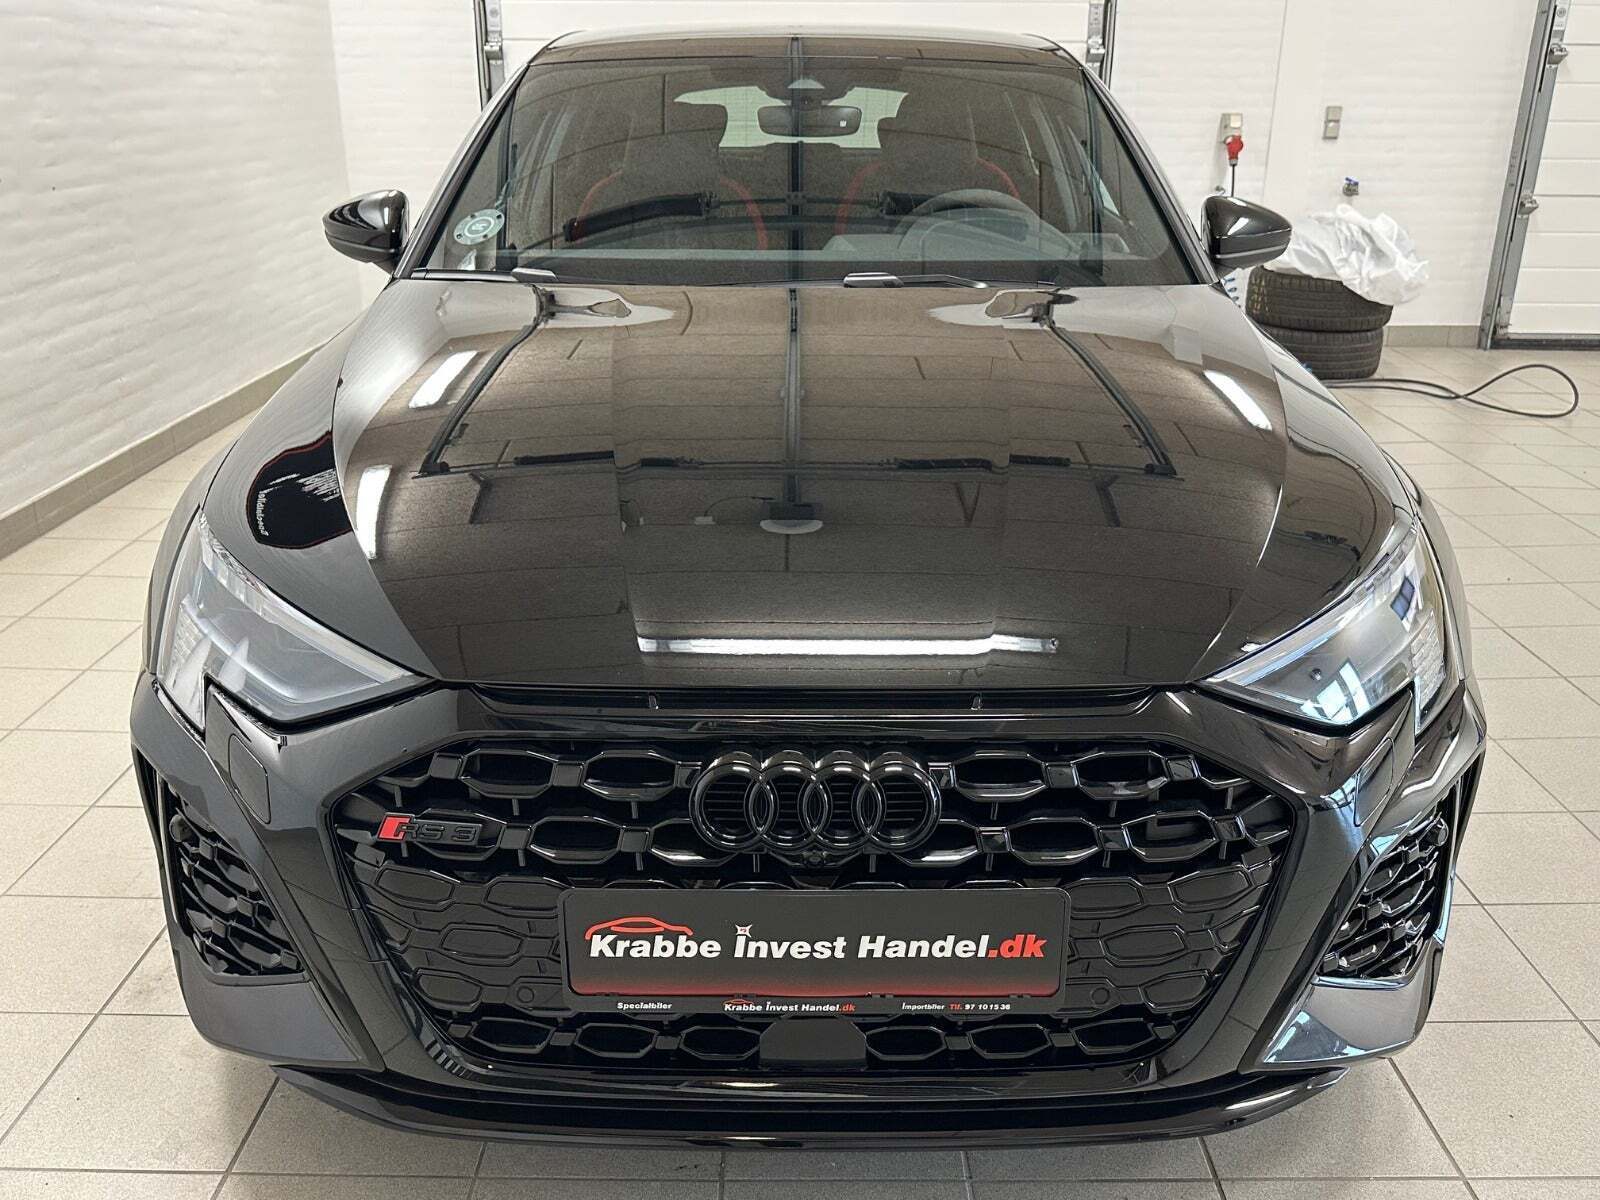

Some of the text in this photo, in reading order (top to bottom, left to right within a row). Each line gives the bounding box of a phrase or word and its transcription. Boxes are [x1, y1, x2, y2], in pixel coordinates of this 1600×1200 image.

[589, 933, 1048, 960] Krabbe Invest Handel.dk
[616, 1002, 673, 1011] Specialbiler
[723, 1002, 857, 1013] Krabbe Invest Handel.dk
[901, 1002, 946, 1011] Importbiler
[964, 1003, 976, 1011] 97
